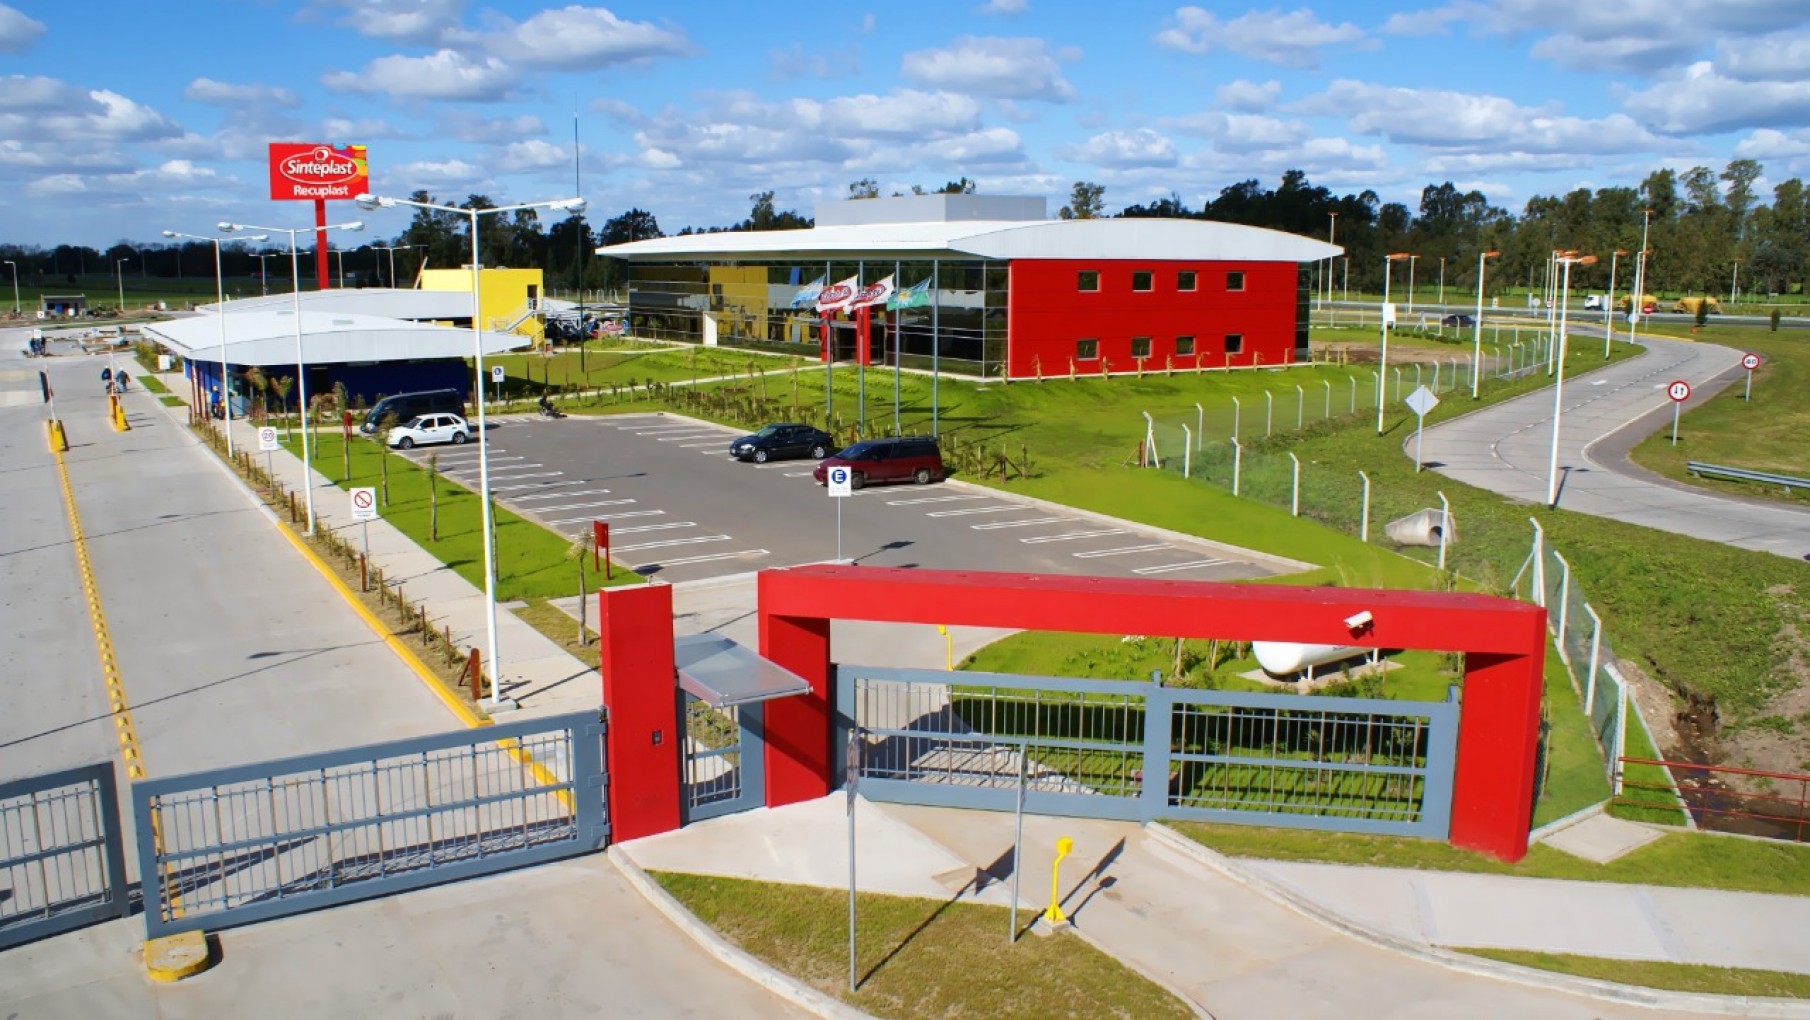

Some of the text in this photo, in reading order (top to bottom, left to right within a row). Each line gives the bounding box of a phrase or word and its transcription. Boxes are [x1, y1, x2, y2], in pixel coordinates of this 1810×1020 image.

[287, 160, 353, 178] Sinteplast
[293, 184, 349, 198] Recuplast
[835, 470, 844, 482] E
